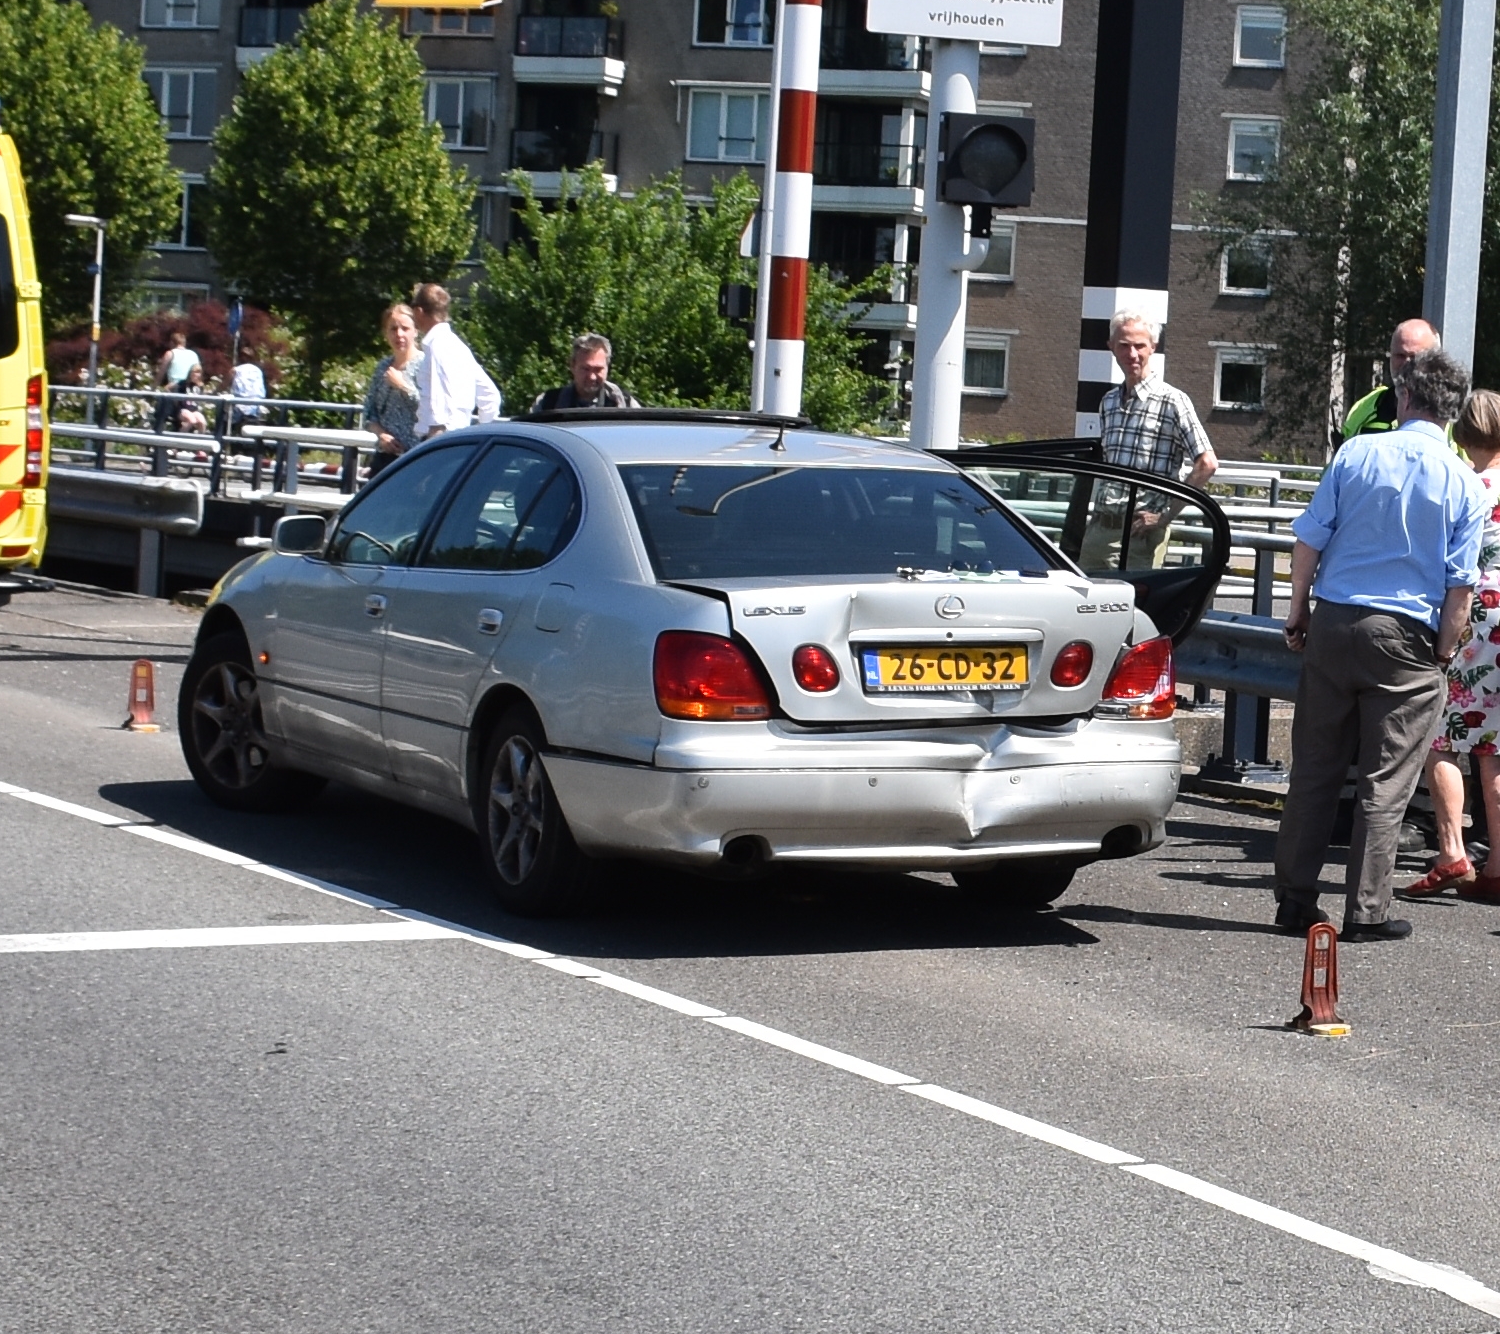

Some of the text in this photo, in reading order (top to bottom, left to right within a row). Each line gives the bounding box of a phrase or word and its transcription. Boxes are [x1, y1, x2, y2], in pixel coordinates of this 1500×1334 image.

[928, 10, 1004, 27] vrijhouden
[742, 605, 807, 618] LEXUS
[889, 651, 1016, 681] 26-CD-32
